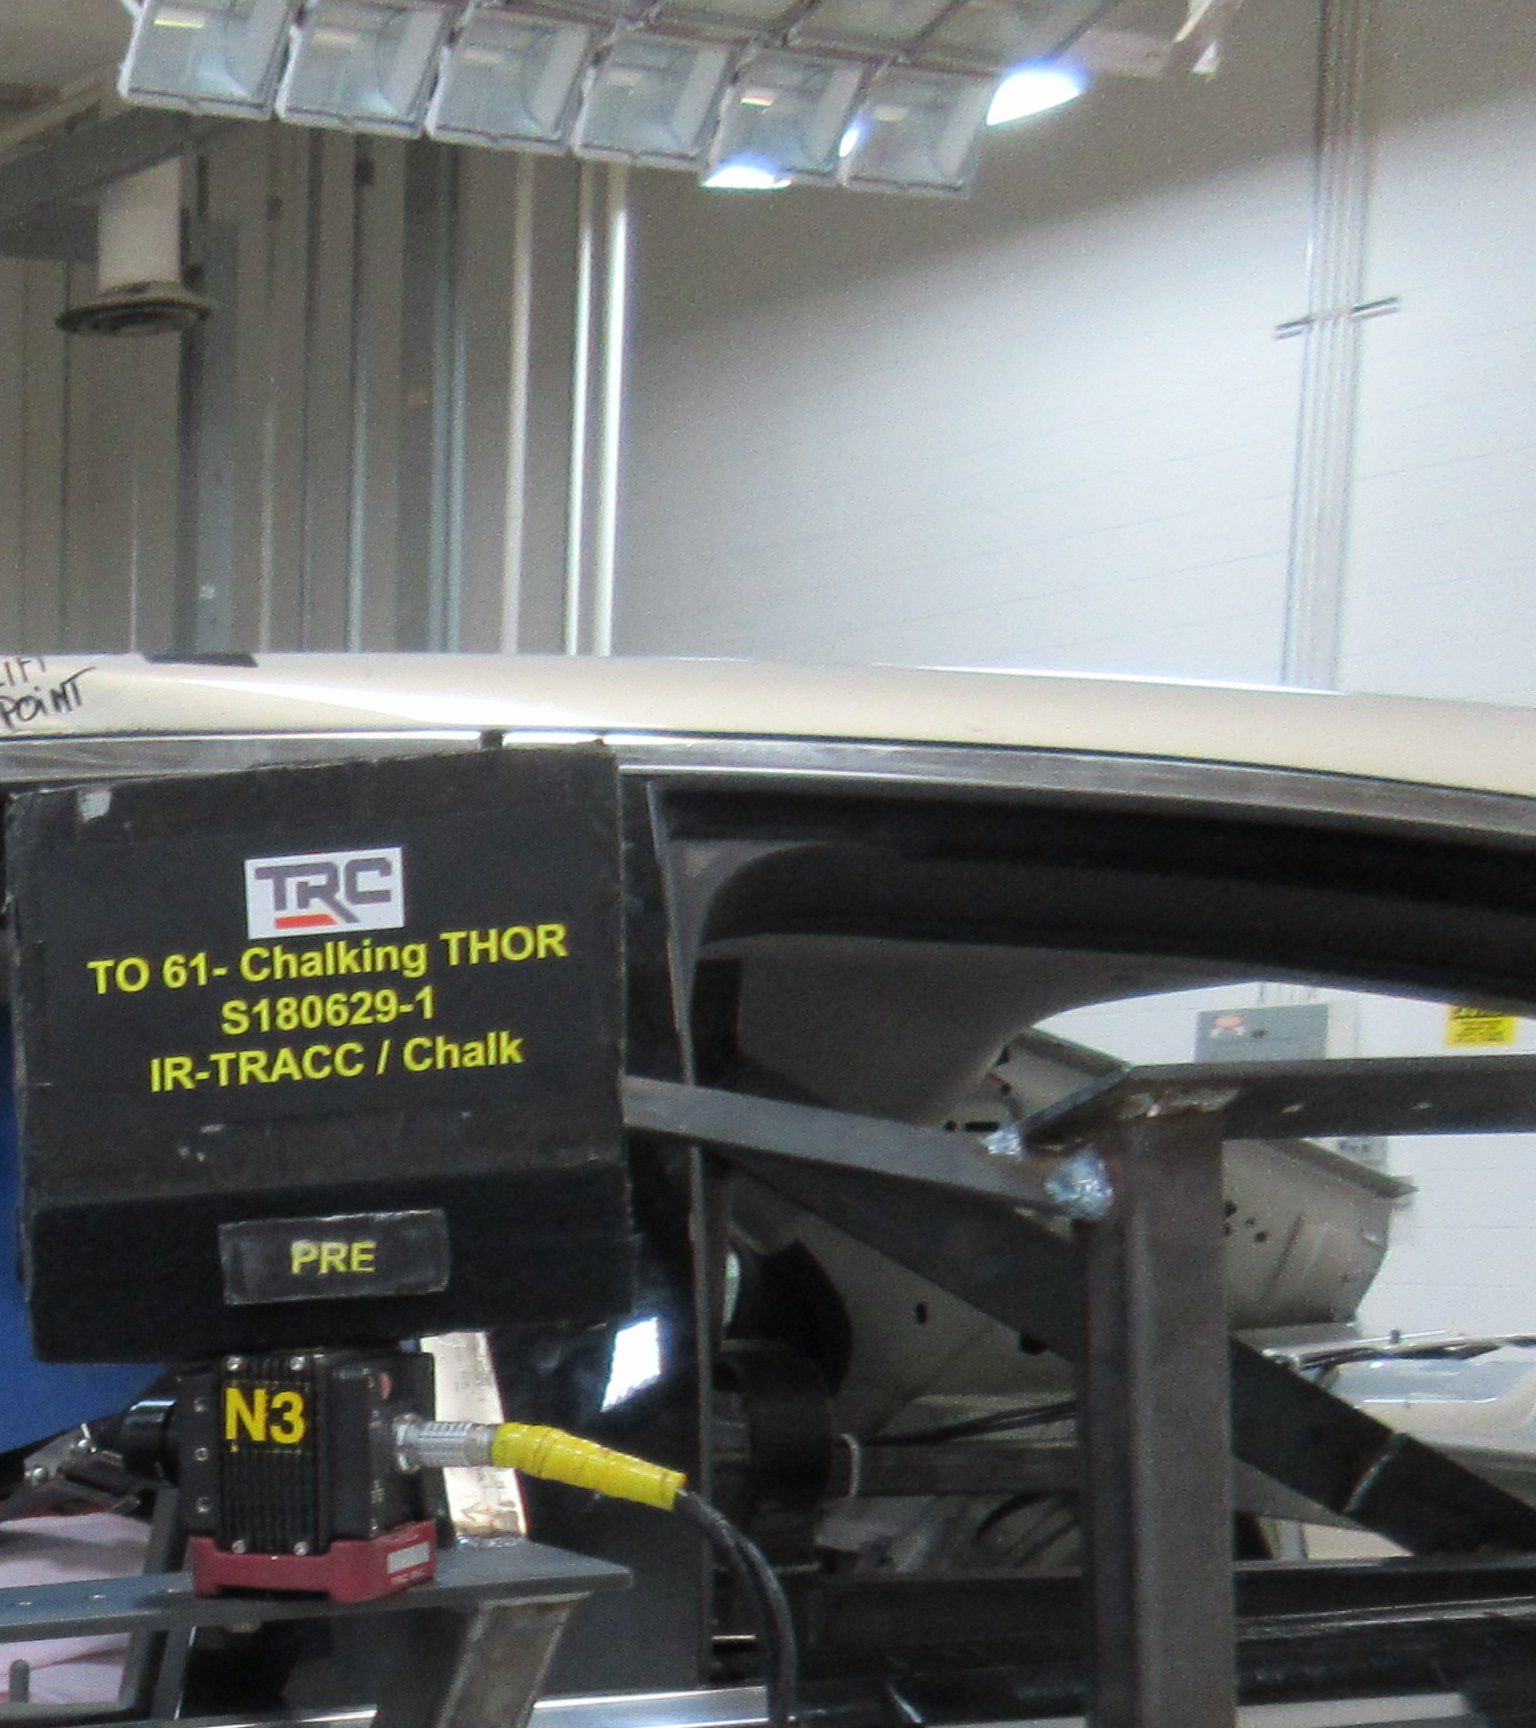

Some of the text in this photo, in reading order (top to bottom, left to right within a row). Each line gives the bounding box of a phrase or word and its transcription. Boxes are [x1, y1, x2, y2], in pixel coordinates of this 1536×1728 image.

[255, 857, 393, 923] TRC
[87, 923, 570, 995] TO 61- Chalking THOR
[220, 985, 435, 1036] S180629-1
[150, 1041, 365, 1093] IR-TRACC
[402, 1030, 526, 1072] Chalk
[290, 1238, 378, 1275] PRE
[225, 1387, 306, 1444] N3
